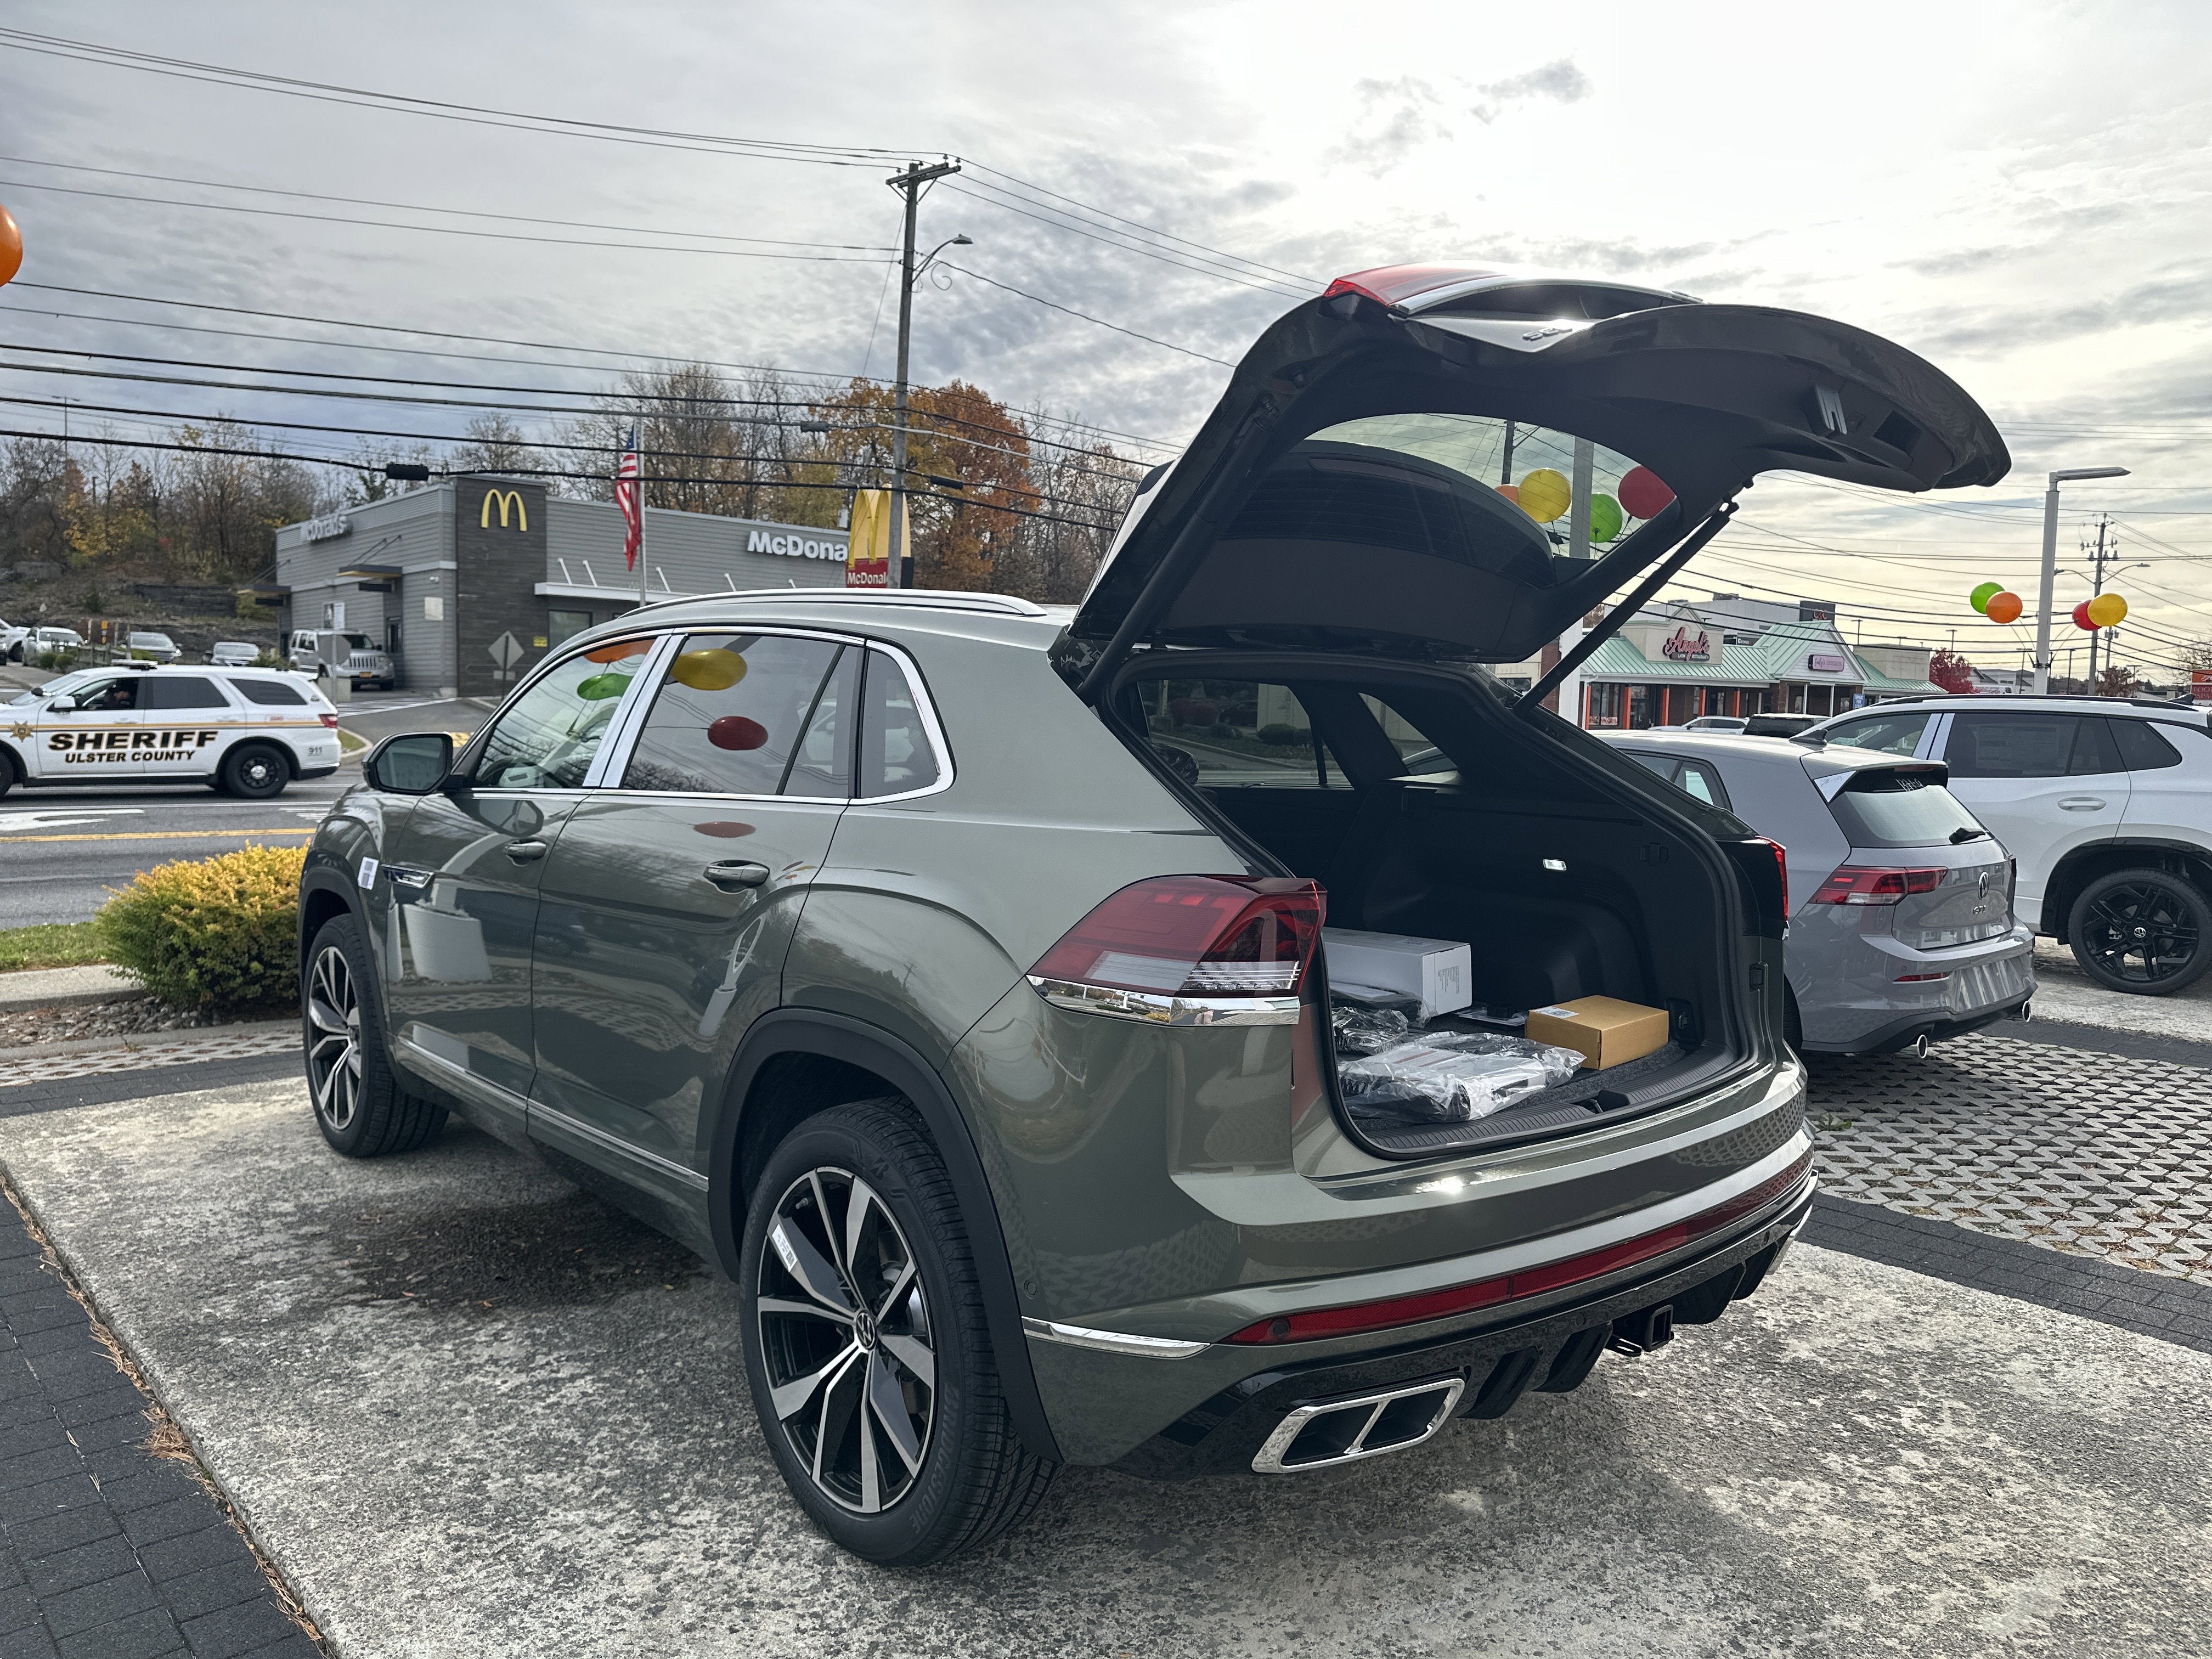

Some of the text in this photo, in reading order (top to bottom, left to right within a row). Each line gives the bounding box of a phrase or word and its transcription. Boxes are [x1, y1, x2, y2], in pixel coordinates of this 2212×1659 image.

[747, 530, 848, 562] McDona
[847, 571, 888, 584] McDonal
[1664, 627, 1709, 661] Angel's
[48, 730, 218, 751] SHERIFF
[308, 746, 323, 755] 911
[65, 749, 195, 764] ULSTER COUNTY
[909, 1382, 960, 1534] BRIDGESTONE
